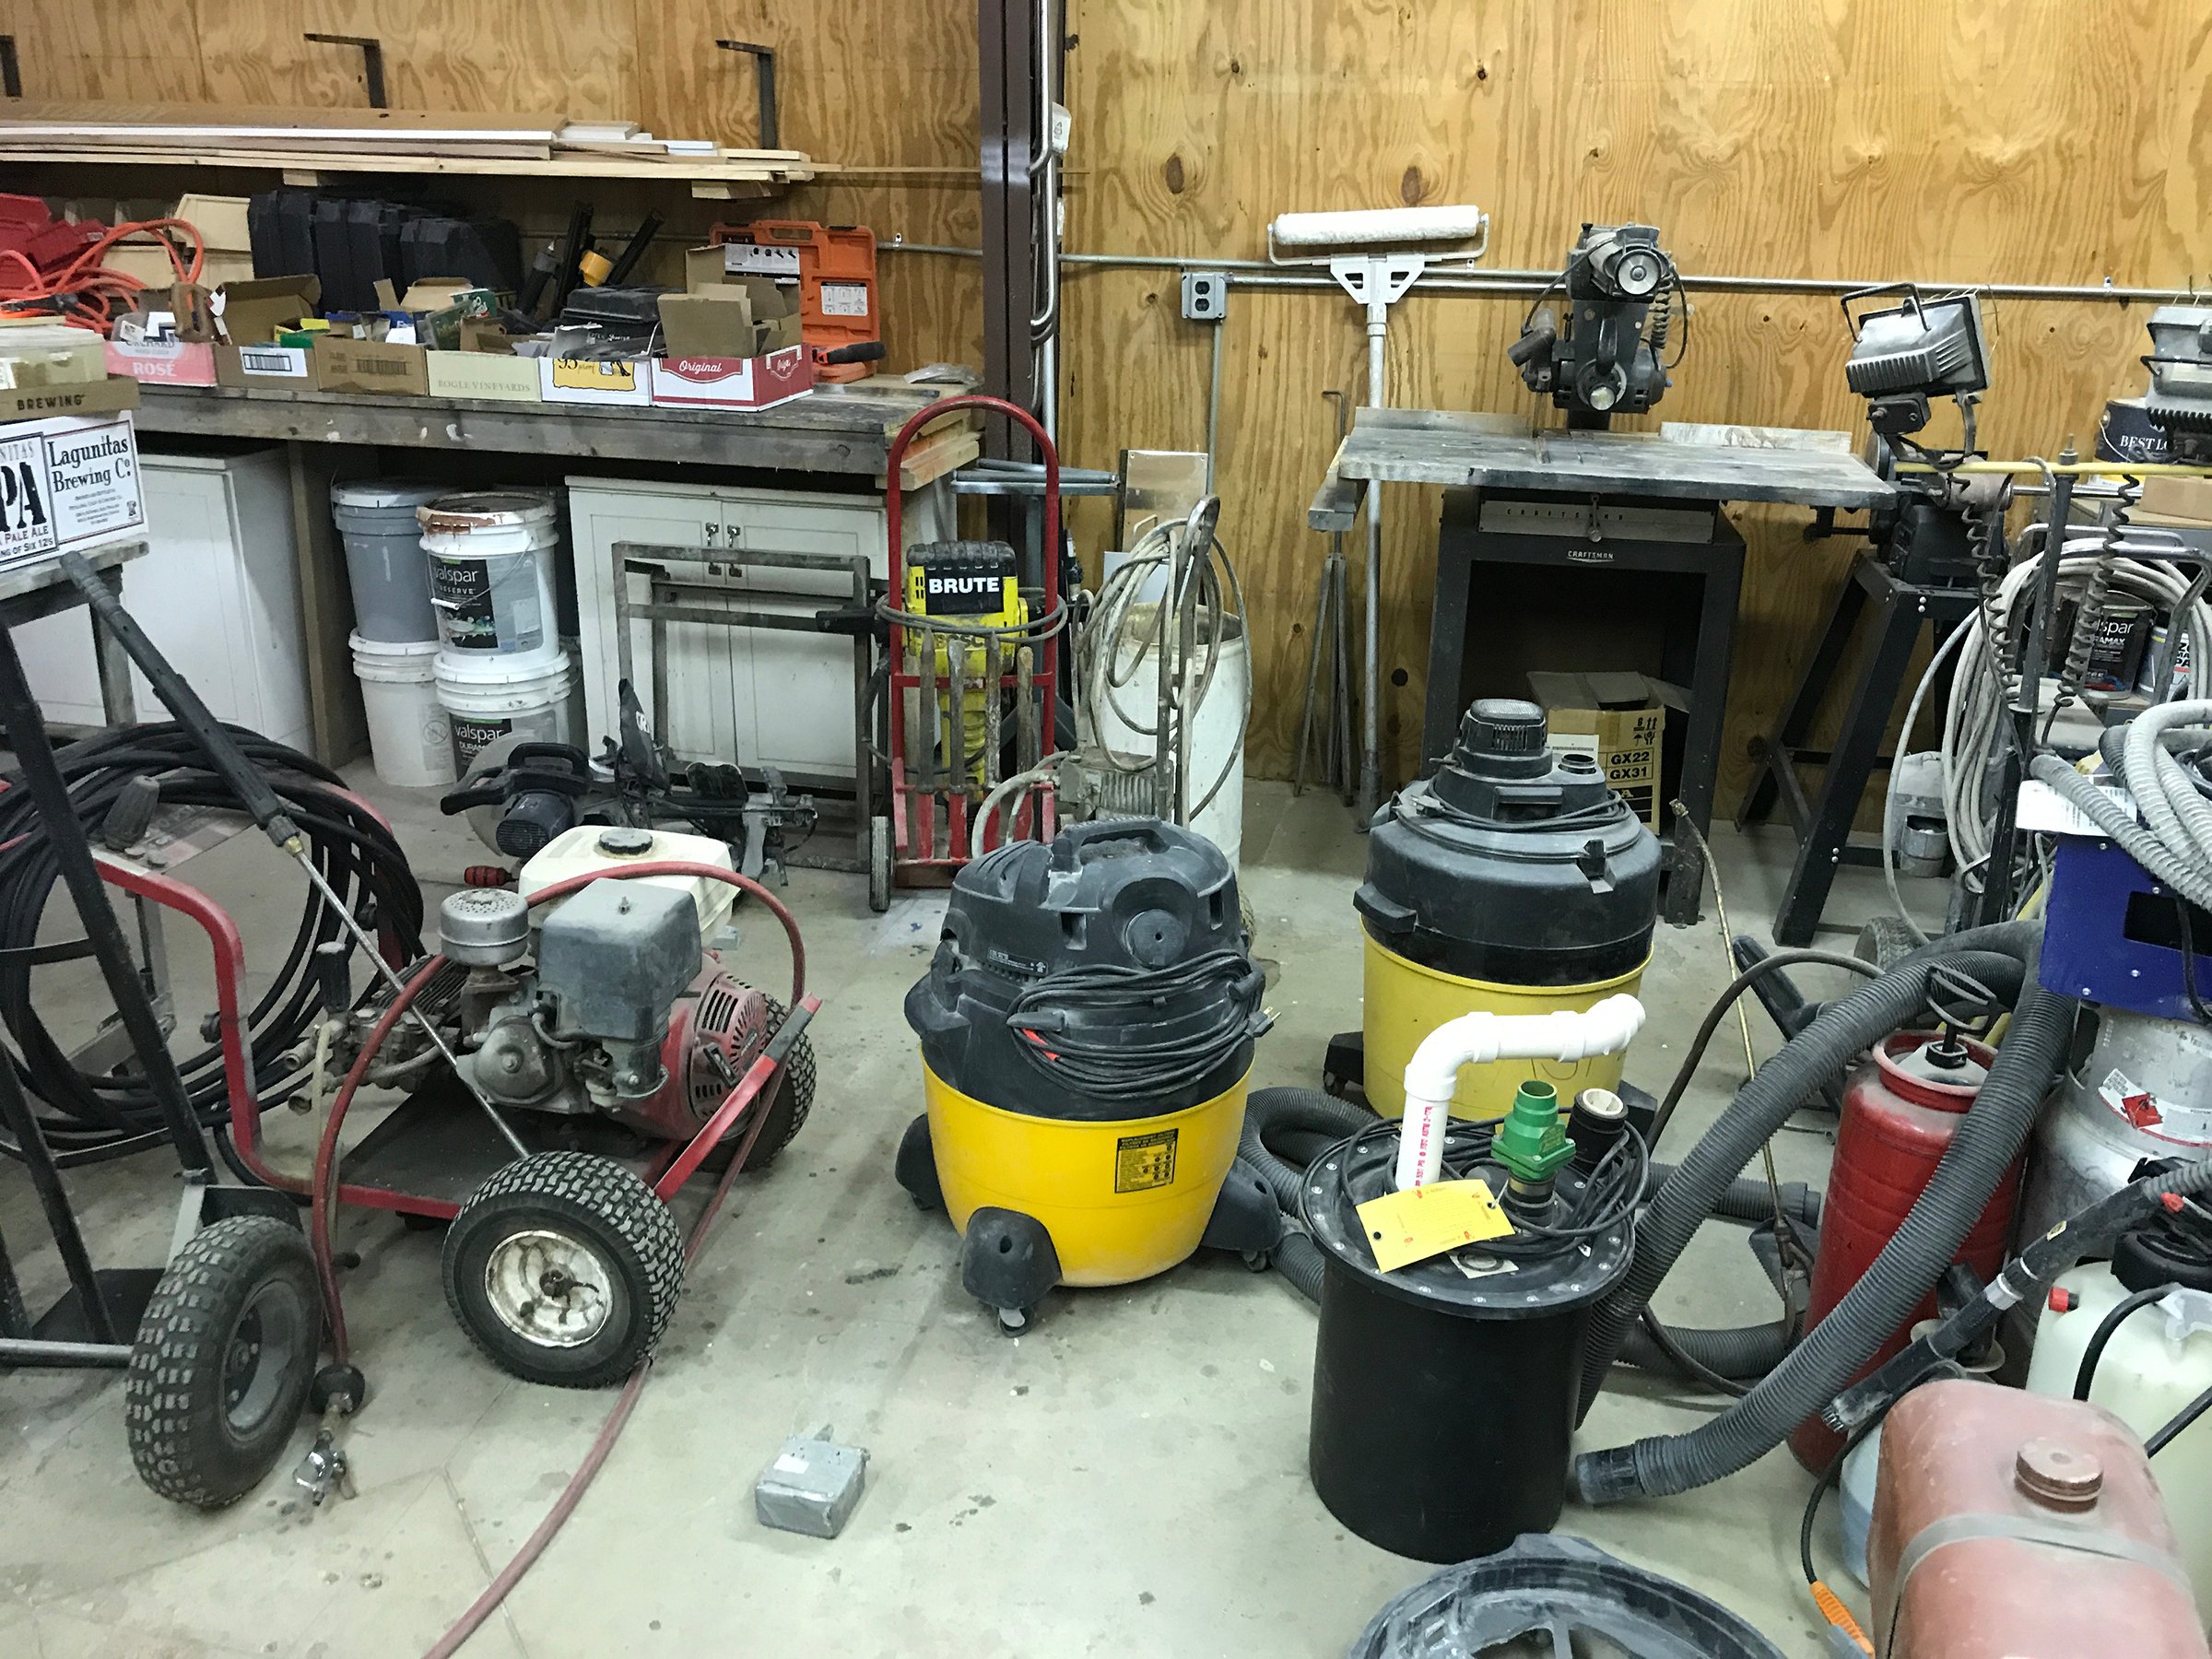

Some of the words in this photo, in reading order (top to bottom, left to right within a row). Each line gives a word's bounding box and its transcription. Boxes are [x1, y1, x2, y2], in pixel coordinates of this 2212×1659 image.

[133, 360, 177, 376] ROSÉ
[679, 360, 722, 374] Original
[439, 380, 468, 389] BOGLE
[472, 382, 531, 392] VINEYARDS
[18, 394, 84, 410] BREWING
[2120, 435, 2155, 450] BEST
[47, 435, 128, 468] Lagunitas
[53, 467, 111, 492] Brewing
[1568, 550, 1614, 559] CRAFTSMAN
[433, 565, 477, 585] valspar
[929, 577, 1000, 594] BRUTE
[2097, 618, 2134, 636] lspar
[454, 724, 502, 744] valspar
[1611, 751, 1650, 765] GX22
[1610, 767, 1647, 780] GX31
